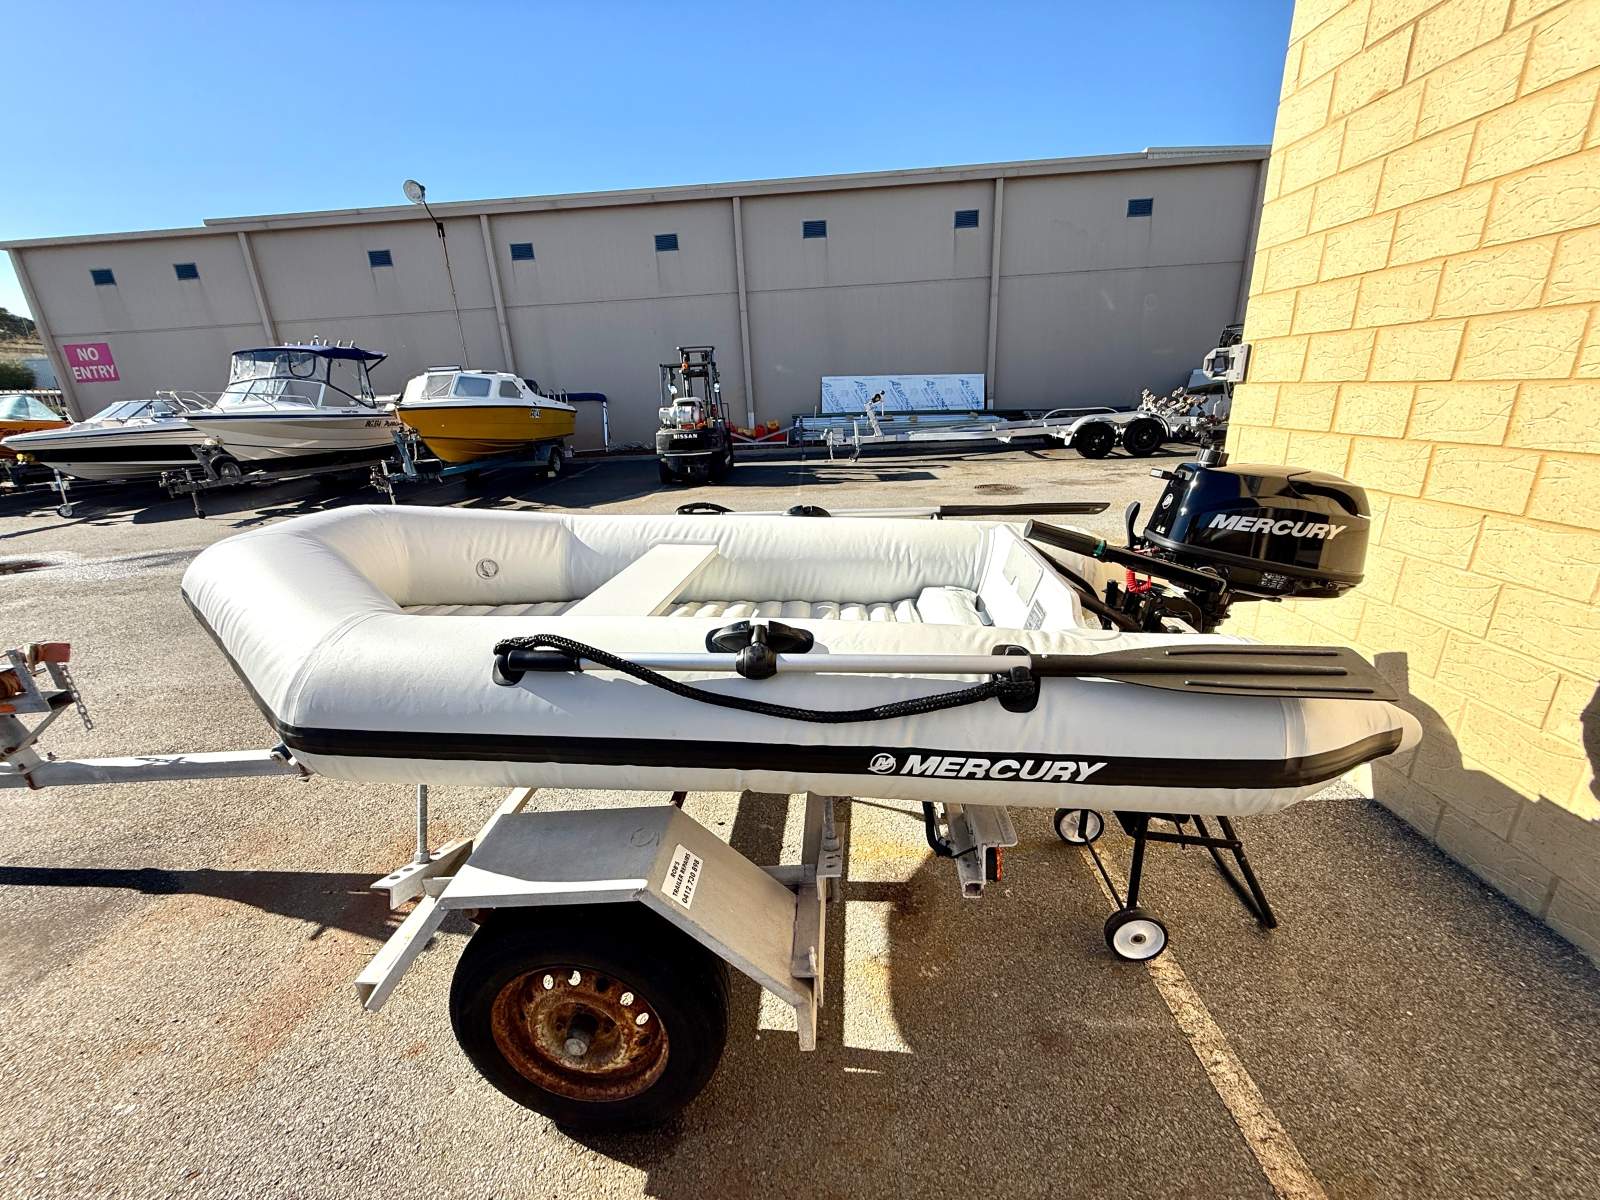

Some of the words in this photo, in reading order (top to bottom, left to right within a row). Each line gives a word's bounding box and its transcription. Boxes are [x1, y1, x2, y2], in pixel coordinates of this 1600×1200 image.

[76, 347, 99, 361] NO
[72, 365, 115, 379] ENTRY
[1208, 513, 1347, 540] MERCURY
[900, 754, 1108, 782] MERCURY
[672, 873, 683, 896] TRAILER
[680, 852, 691, 874] REPAIRS
[682, 885, 692, 904] 0412
[688, 871, 696, 886] 730
